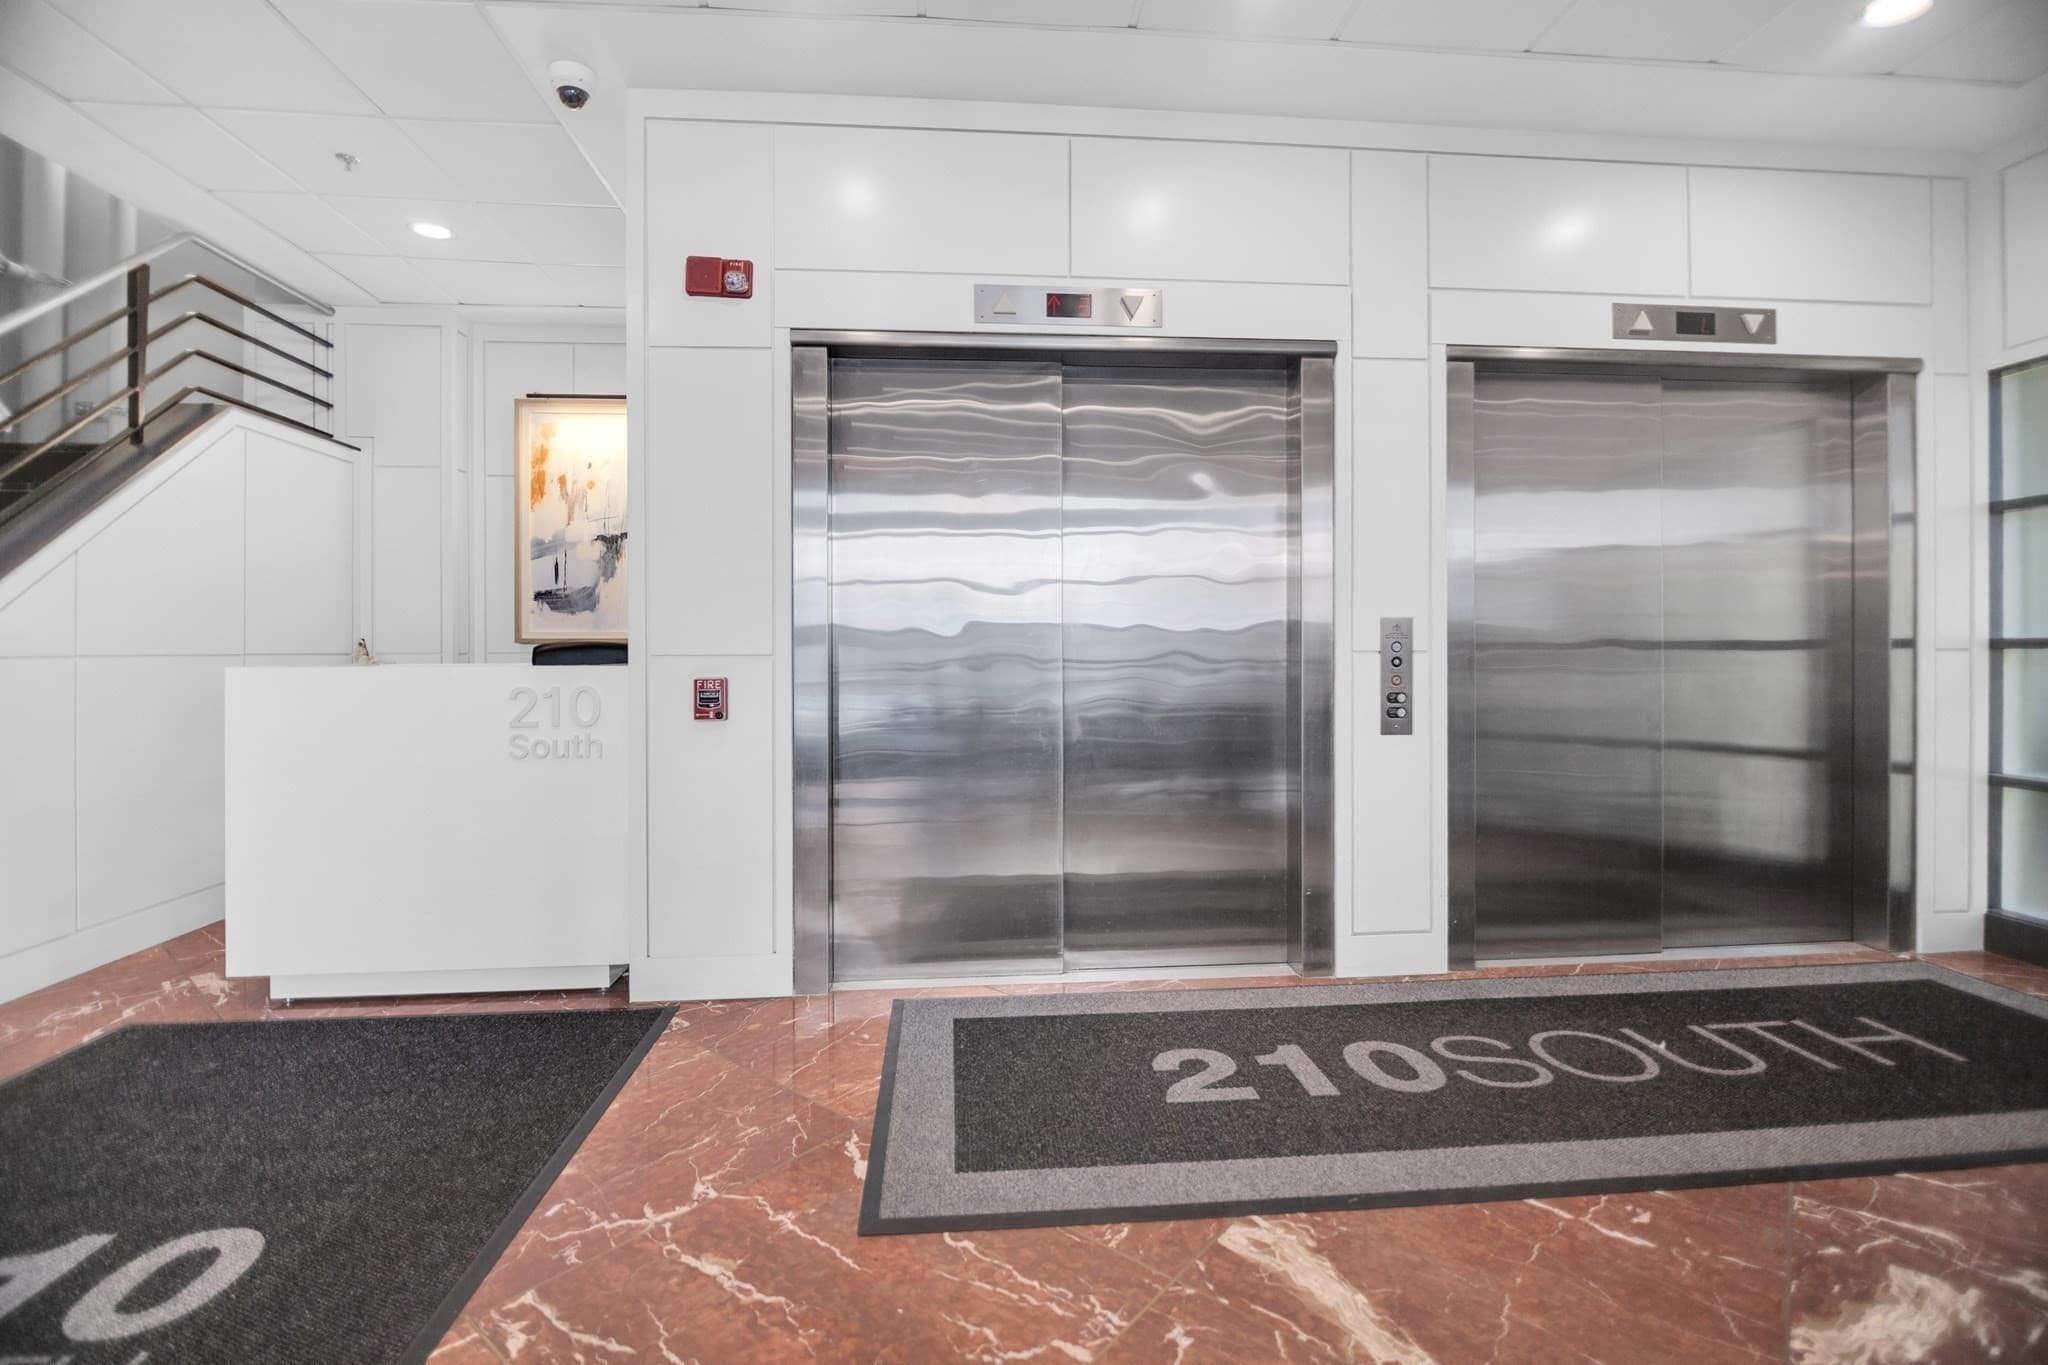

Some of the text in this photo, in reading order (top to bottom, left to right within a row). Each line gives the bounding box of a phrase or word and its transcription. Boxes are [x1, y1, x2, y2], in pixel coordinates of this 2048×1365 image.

[696, 680, 721, 689] FIRE
[508, 685, 602, 728] 210
[508, 732, 604, 761] South
[1151, 1017, 1969, 1103] 210SOUTH
